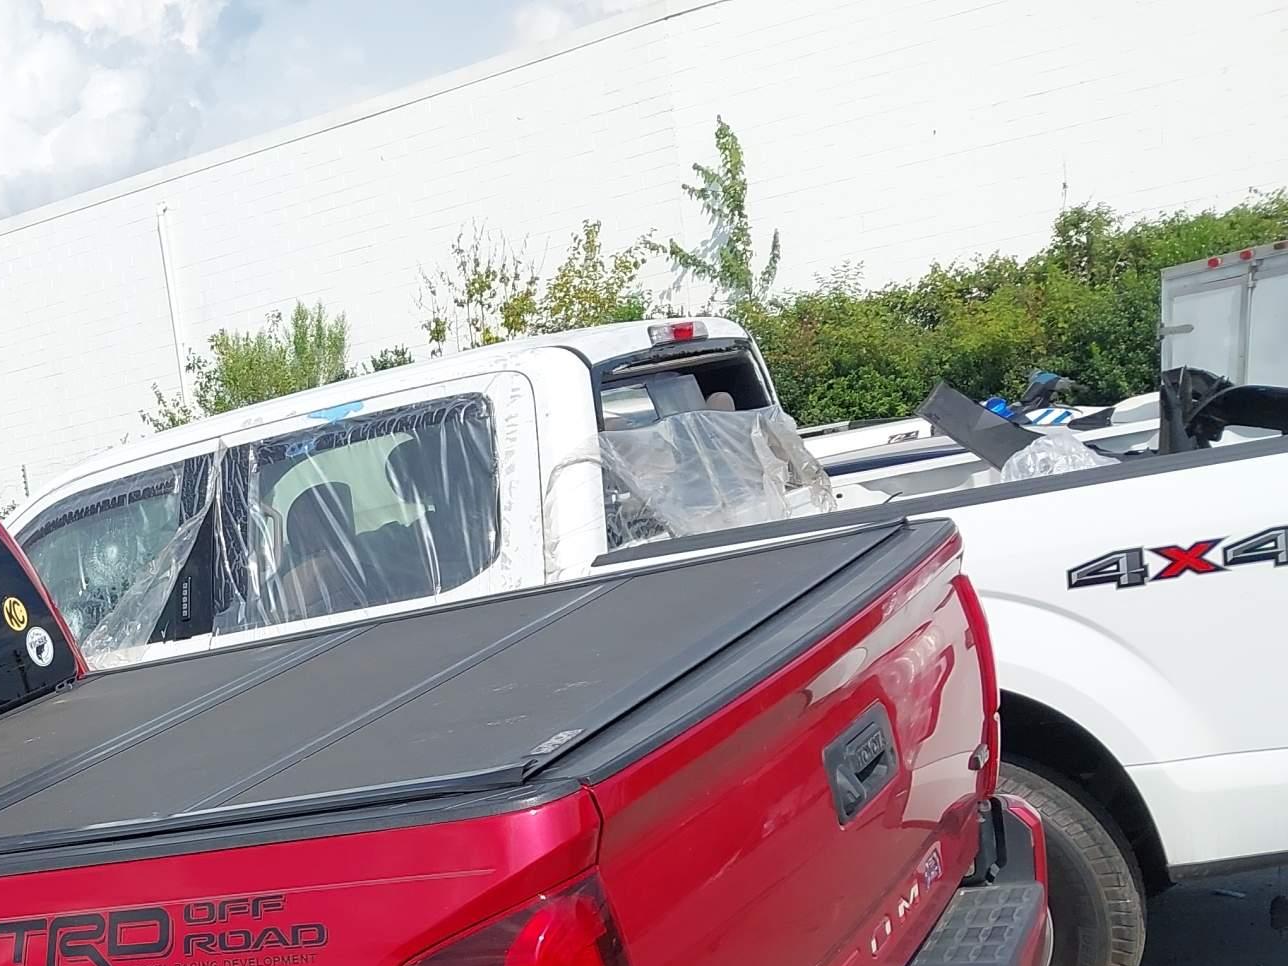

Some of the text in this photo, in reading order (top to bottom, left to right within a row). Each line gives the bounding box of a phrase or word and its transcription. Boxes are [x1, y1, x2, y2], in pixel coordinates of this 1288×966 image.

[5, 599, 25, 628] KC
[182, 894, 287, 925] OFF
[182, 922, 328, 957] ROAD
